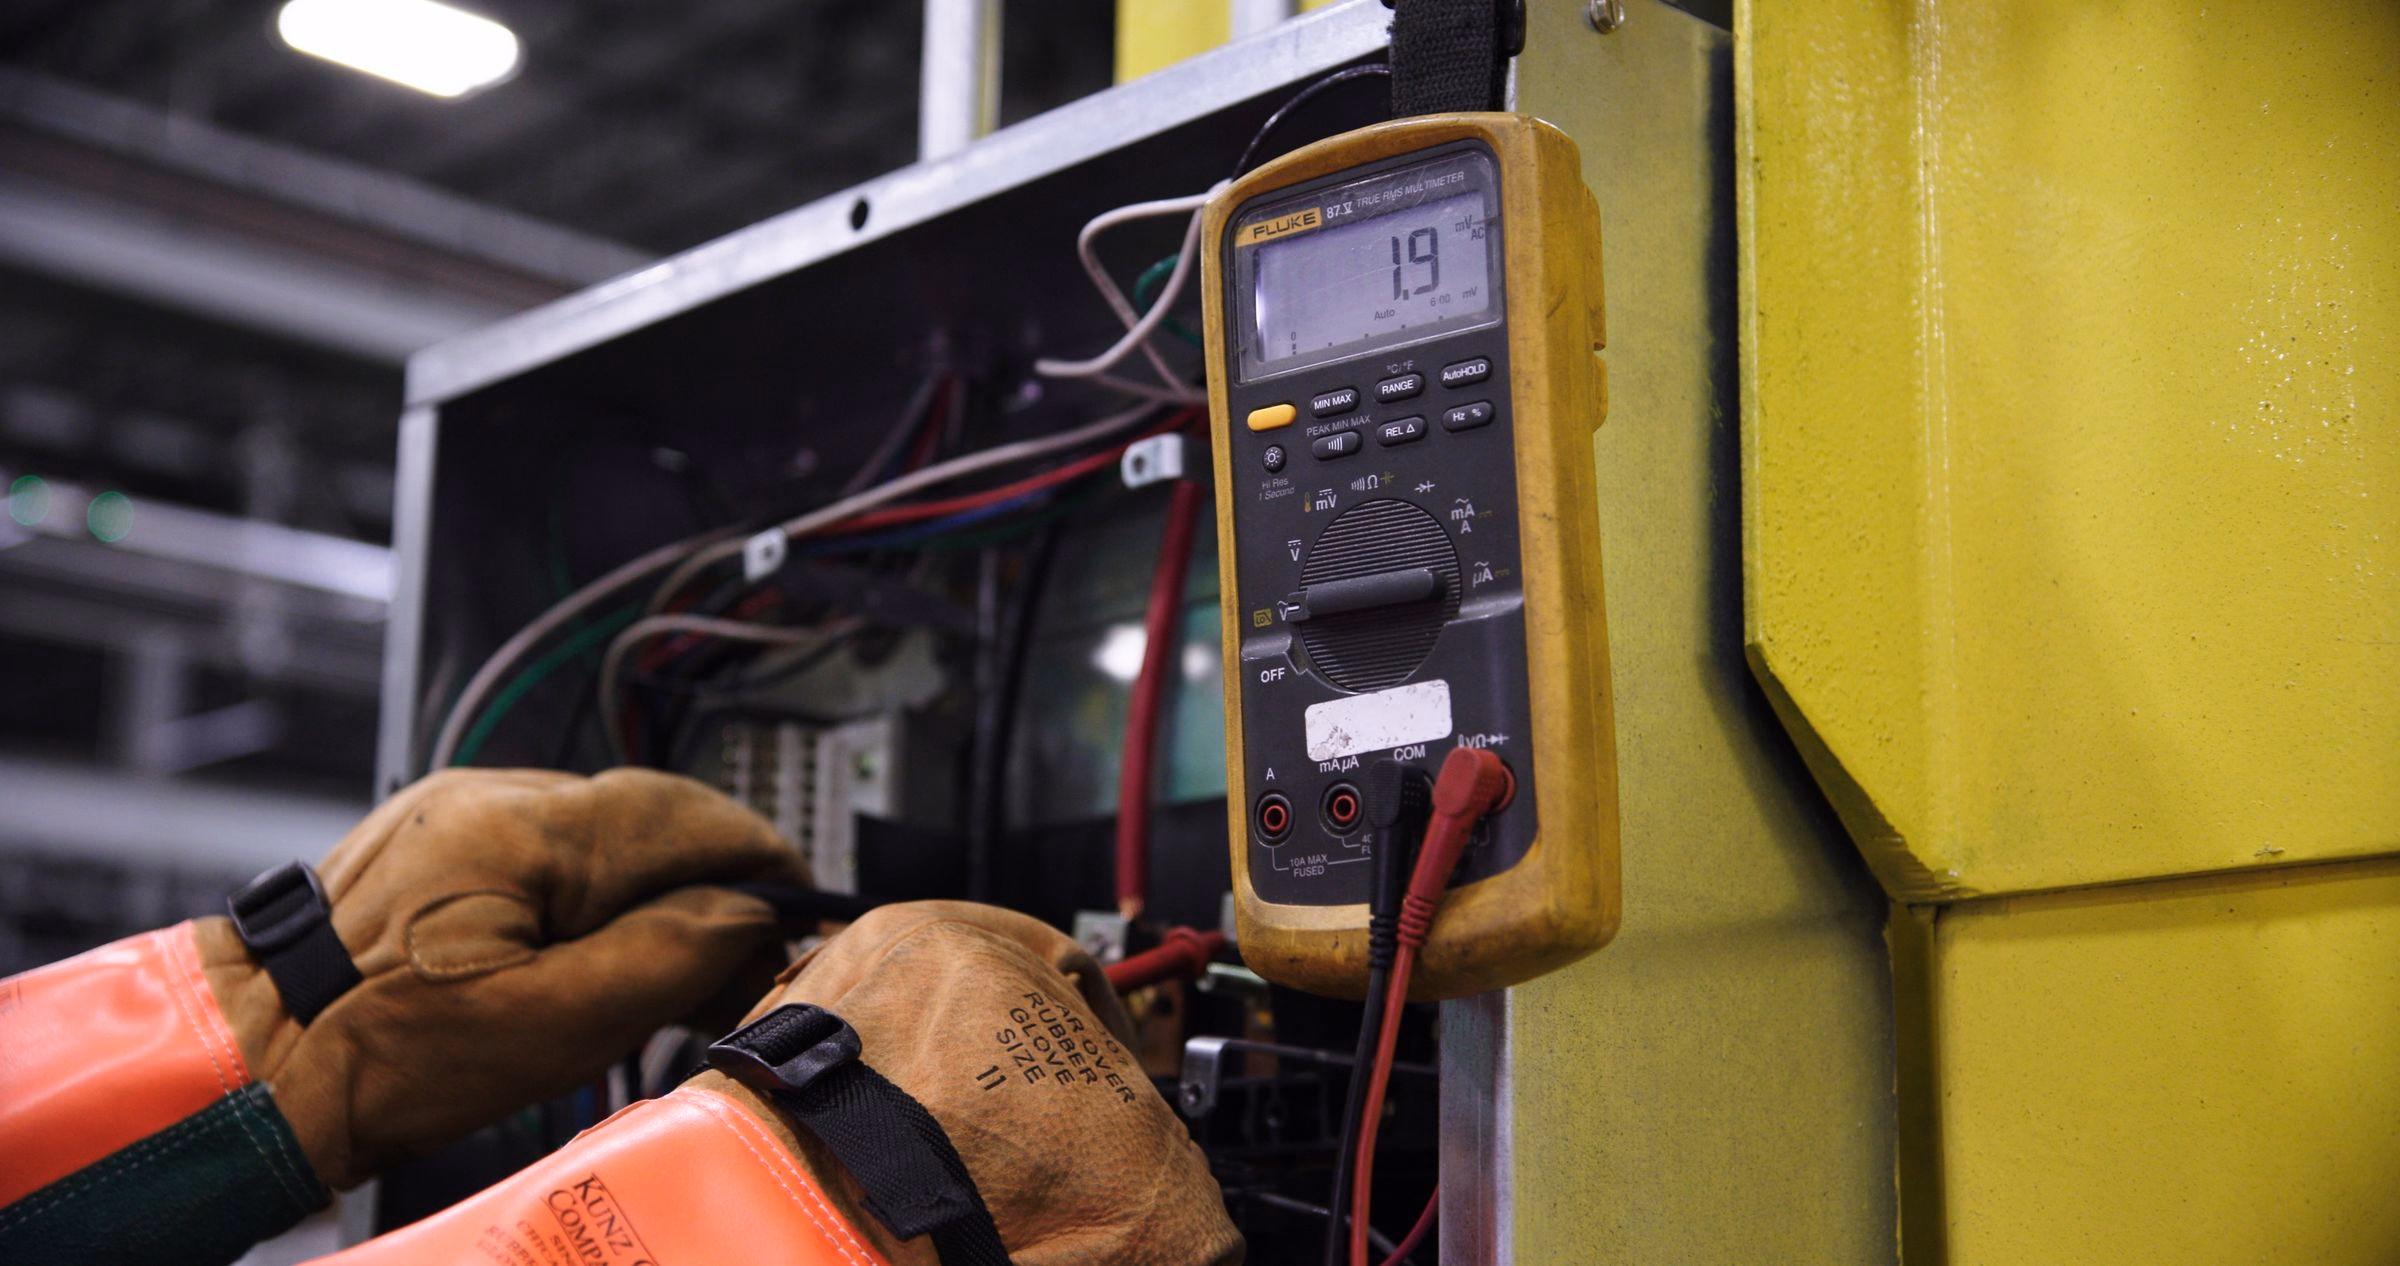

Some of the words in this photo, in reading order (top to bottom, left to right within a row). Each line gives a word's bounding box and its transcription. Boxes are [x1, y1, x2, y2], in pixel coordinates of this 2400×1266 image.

[1356, 194, 1381, 208] TRUE
[1382, 187, 1404, 202] RMS
[1405, 171, 1465, 194] MULTIMETER
[1326, 205, 1340, 219] 87
[1253, 211, 1317, 239] FLUKE
[1471, 227, 1485, 241] AC
[1391, 226, 1439, 301] 1.9
[1374, 309, 1396, 321] Auto
[1442, 363, 1486, 381] AutoHOLD
[1381, 379, 1414, 395] RANGE
[1314, 398, 1331, 410] MIN
[1332, 394, 1352, 406] MAX
[1452, 411, 1466, 422] Hz
[1306, 424, 1331, 438] PEAK
[1332, 419, 1349, 431] MIN
[1350, 414, 1372, 427] MAX
[1385, 428, 1404, 438] REL
[1265, 487, 1295, 500] Second
[1315, 494, 1337, 511] mV
[1451, 503, 1475, 520] mA
[1460, 520, 1472, 534] A
[1260, 667, 1286, 683] OFF
[1394, 744, 1426, 761] COM
[1266, 767, 1276, 781] A
[1290, 857, 1307, 868] 10A
[1307, 854, 1329, 866] MAX
[1293, 865, 1325, 878] FUSED
[1009, 1007, 1075, 1086] GLOVE
[1024, 991, 1098, 1085] RUBBER
[996, 1028, 1047, 1085] SIZE
[976, 1064, 1008, 1092] 11
[1083, 1040, 1137, 1103] OVER
[573, 1176, 634, 1256] KUNZ
